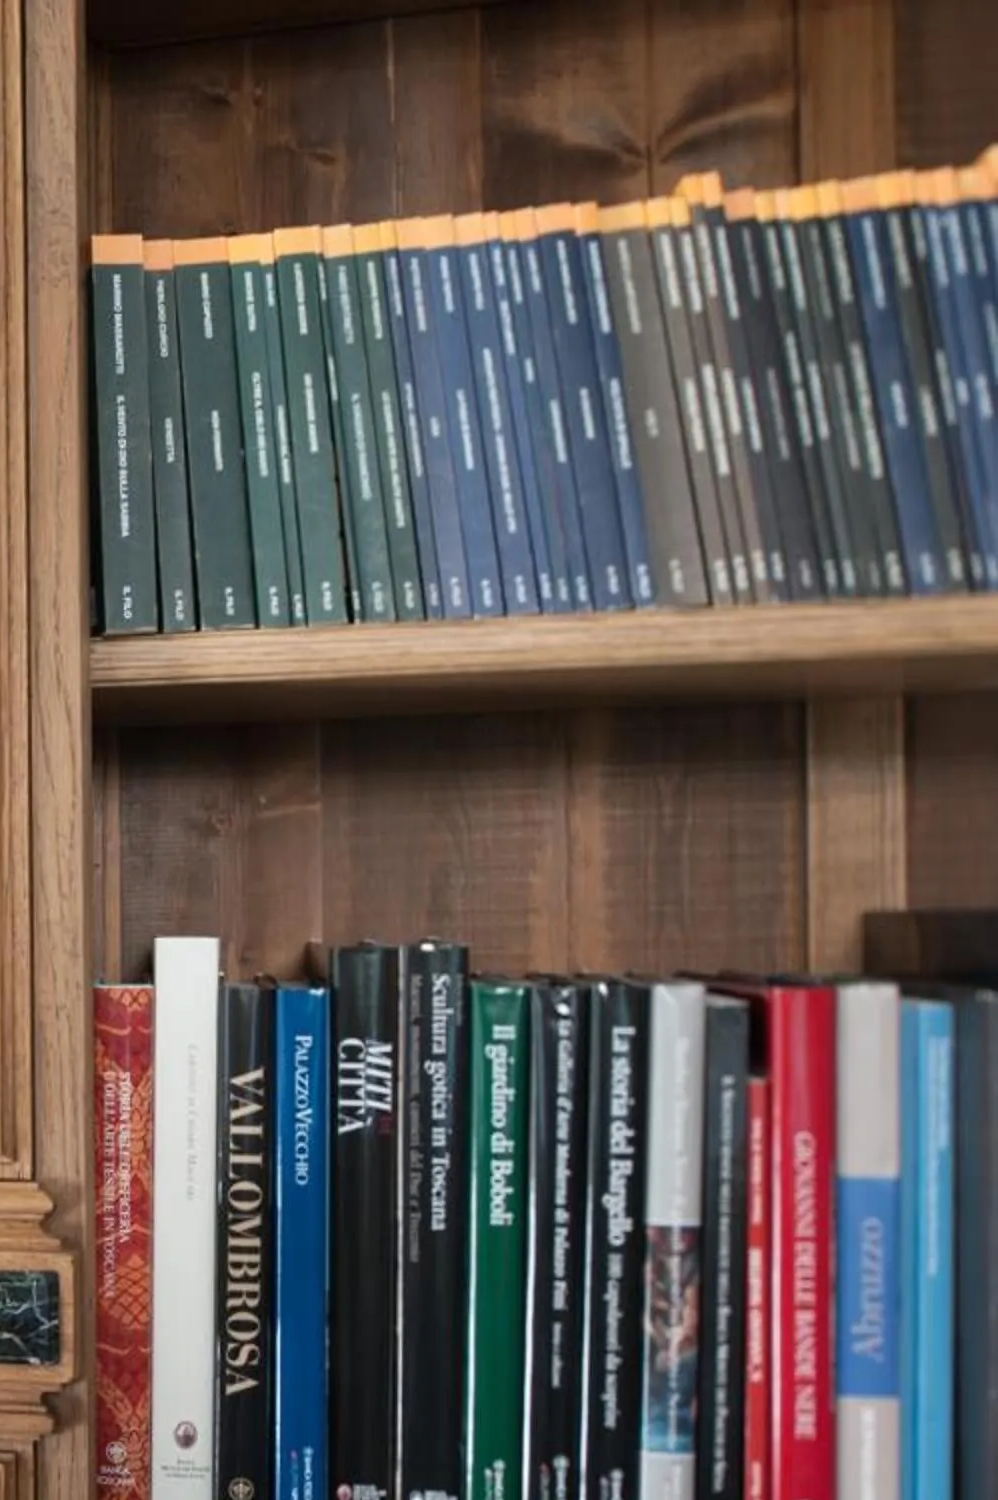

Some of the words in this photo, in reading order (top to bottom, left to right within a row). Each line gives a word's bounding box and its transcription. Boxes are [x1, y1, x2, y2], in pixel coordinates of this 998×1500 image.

[124, 597, 133, 619] FILO
[431, 974, 455, 1055] Scultura
[492, 1024, 515, 1040] Il
[557, 1019, 572, 1037] La
[611, 1025, 636, 1051] La
[337, 1037, 372, 1136] CITTÀ
[366, 1039, 394, 1113] MITI
[424, 1060, 453, 1120] gotica
[485, 1043, 515, 1127] giardino
[556, 1040, 573, 1094] Galleria
[609, 1056, 634, 1117] storia
[103, 1083, 116, 1157] DELL'ARTE
[431, 1127, 453, 1147] in
[490, 1131, 514, 1154] di
[556, 1096, 573, 1140] d'Arte
[609, 1120, 634, 1156] del
[430, 1152, 451, 1231] Toscana
[489, 1159, 514, 1226] Boboli
[555, 1143, 571, 1204] Moderna
[602, 1159, 634, 1247] Bargello
[793, 1130, 817, 1236] GIOVANNI
[103, 1216, 115, 1231] IN
[224, 1066, 266, 1396] VALLOMBROSA
[554, 1207, 570, 1223] di
[553, 1225, 570, 1278] Palazzo
[793, 1240, 817, 1304] DELLE
[602, 1279, 623, 1351] capolavori
[850, 1216, 886, 1363] Abruzzo
[793, 1309, 817, 1381] BANDE
[793, 1385, 817, 1440] NERE
